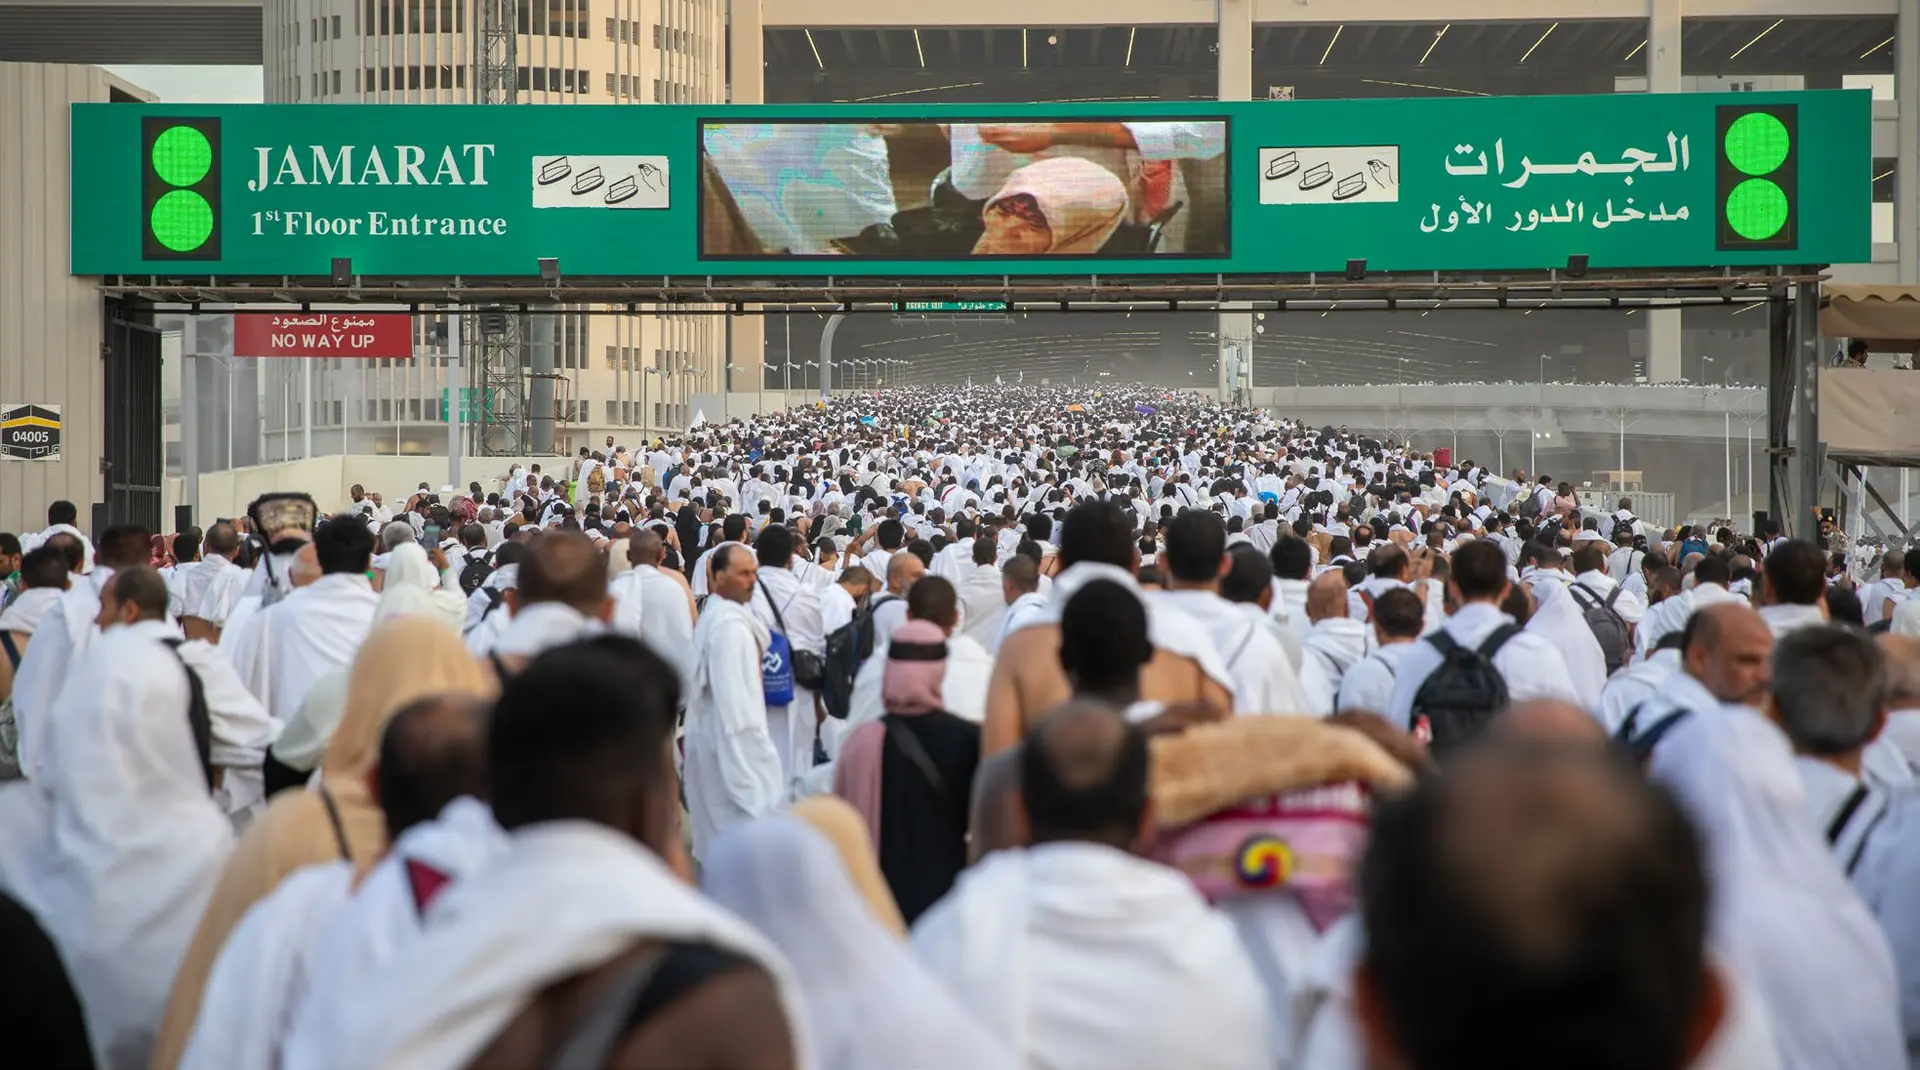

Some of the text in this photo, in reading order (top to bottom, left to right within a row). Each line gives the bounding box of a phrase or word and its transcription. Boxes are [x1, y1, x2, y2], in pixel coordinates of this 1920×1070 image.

[248, 144, 495, 192] JAMARAT
[1445, 131, 1690, 188] الجمرات
[251, 209, 508, 236] 1st Floor Entrance
[1420, 195, 1690, 233] مدخل الدور الأول
[272, 314, 375, 332] ممنوع الصعود
[271, 334, 375, 348] NO WAY UP
[12, 431, 49, 442] 04005
